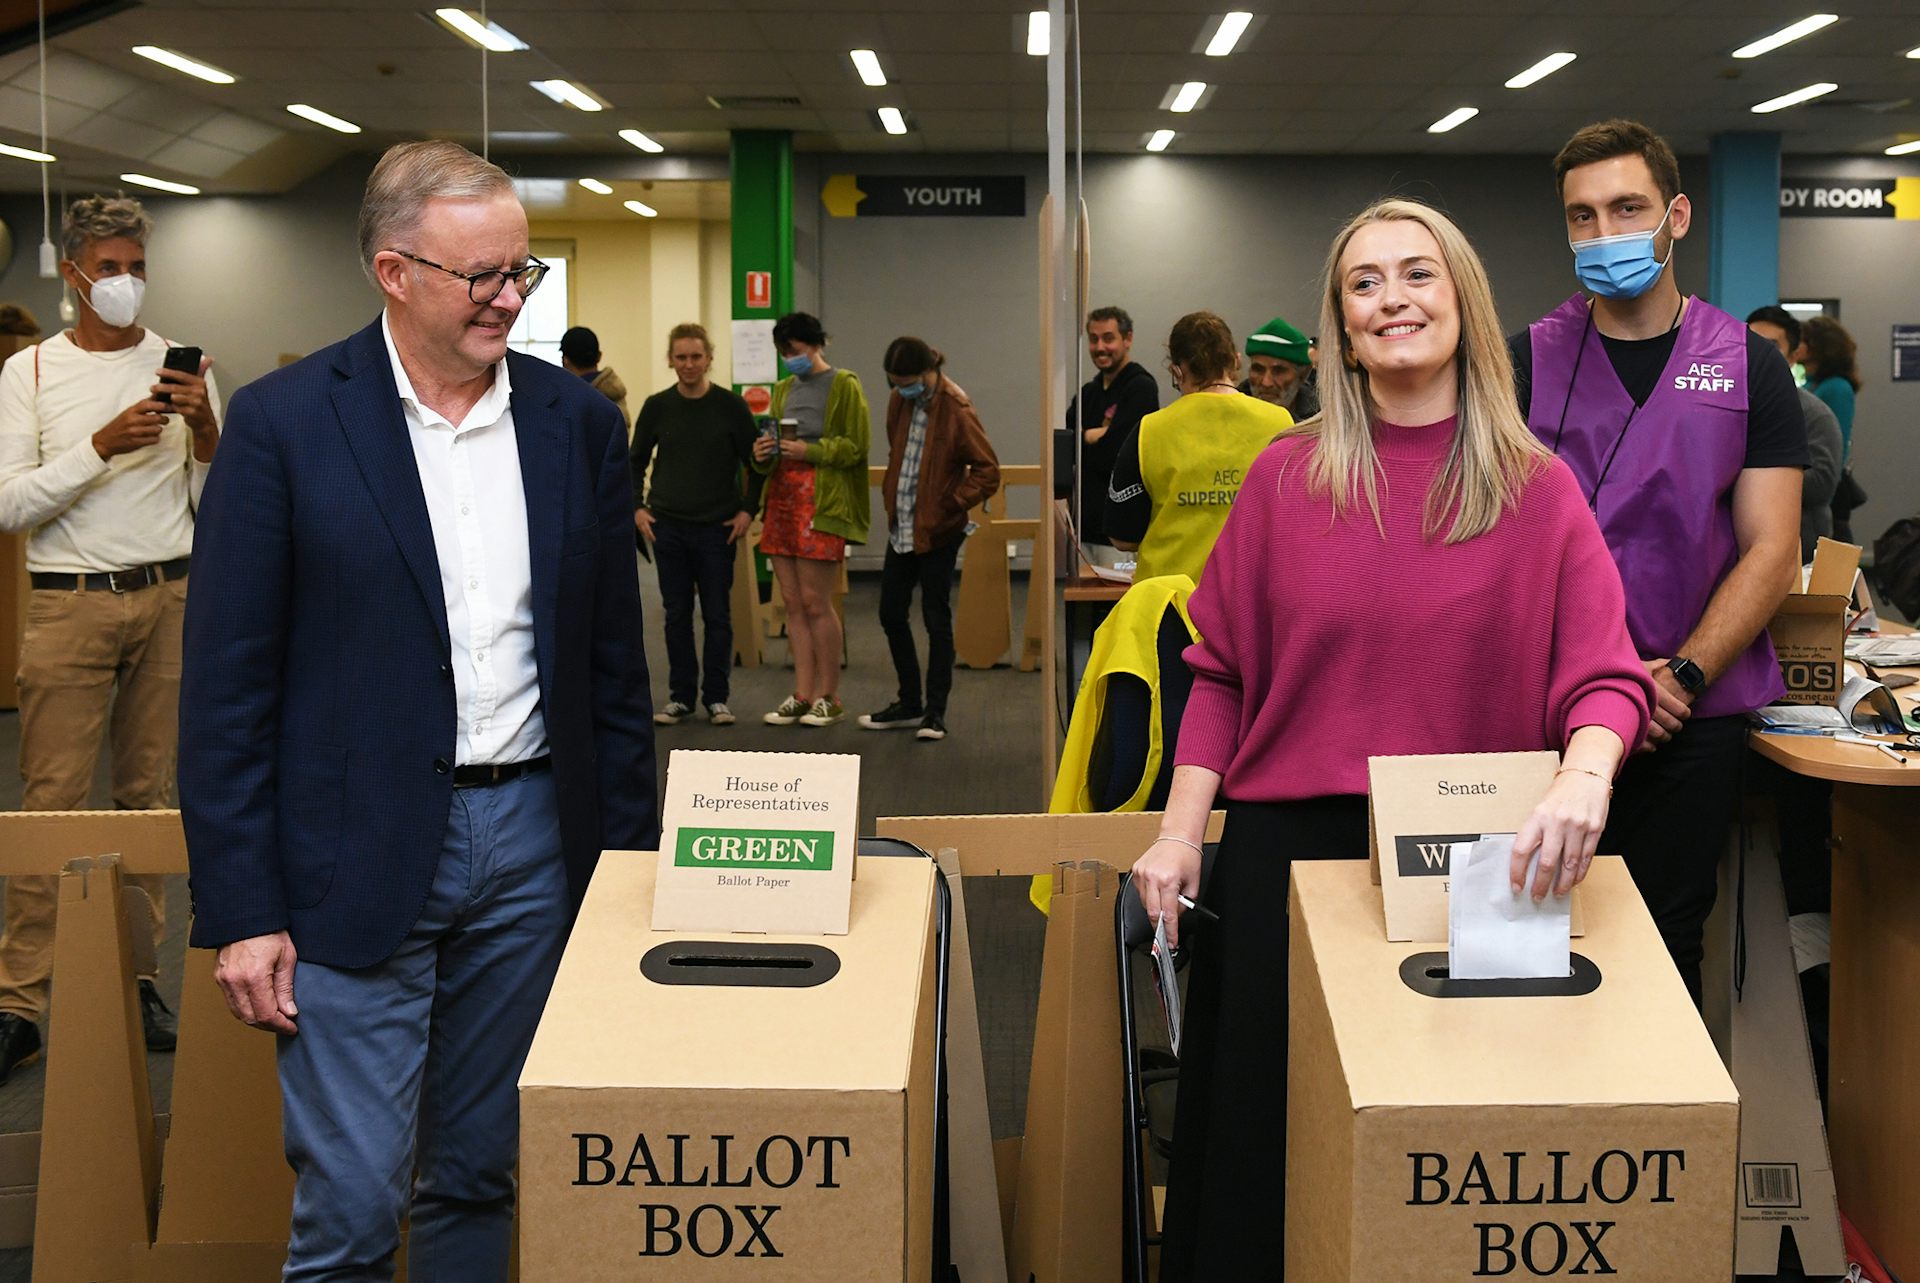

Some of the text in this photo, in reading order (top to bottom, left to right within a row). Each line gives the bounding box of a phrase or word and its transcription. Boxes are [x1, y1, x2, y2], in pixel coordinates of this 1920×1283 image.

[903, 187, 982, 205] YOUTH
[1813, 188, 1883, 209] ROOM
[1688, 362, 1723, 378] AEC
[1674, 375, 1735, 393] STAFF
[1213, 469, 1240, 486] AEC
[1177, 491, 1239, 507] SUPERV
[1780, 664, 1834, 689] OS
[1780, 693, 1835, 701] .cos.net.au
[725, 776, 802, 793] House of
[1438, 780, 1497, 795] Senate
[692, 793, 829, 812] Representatives
[691, 835, 819, 863] GREEN
[717, 875, 790, 889] Ballot Paper
[571, 1133, 850, 1189] BALLOT
[1405, 1150, 1686, 1205] BALLOT
[638, 1203, 784, 1258] BOX
[1472, 1221, 1618, 1276] BOX
